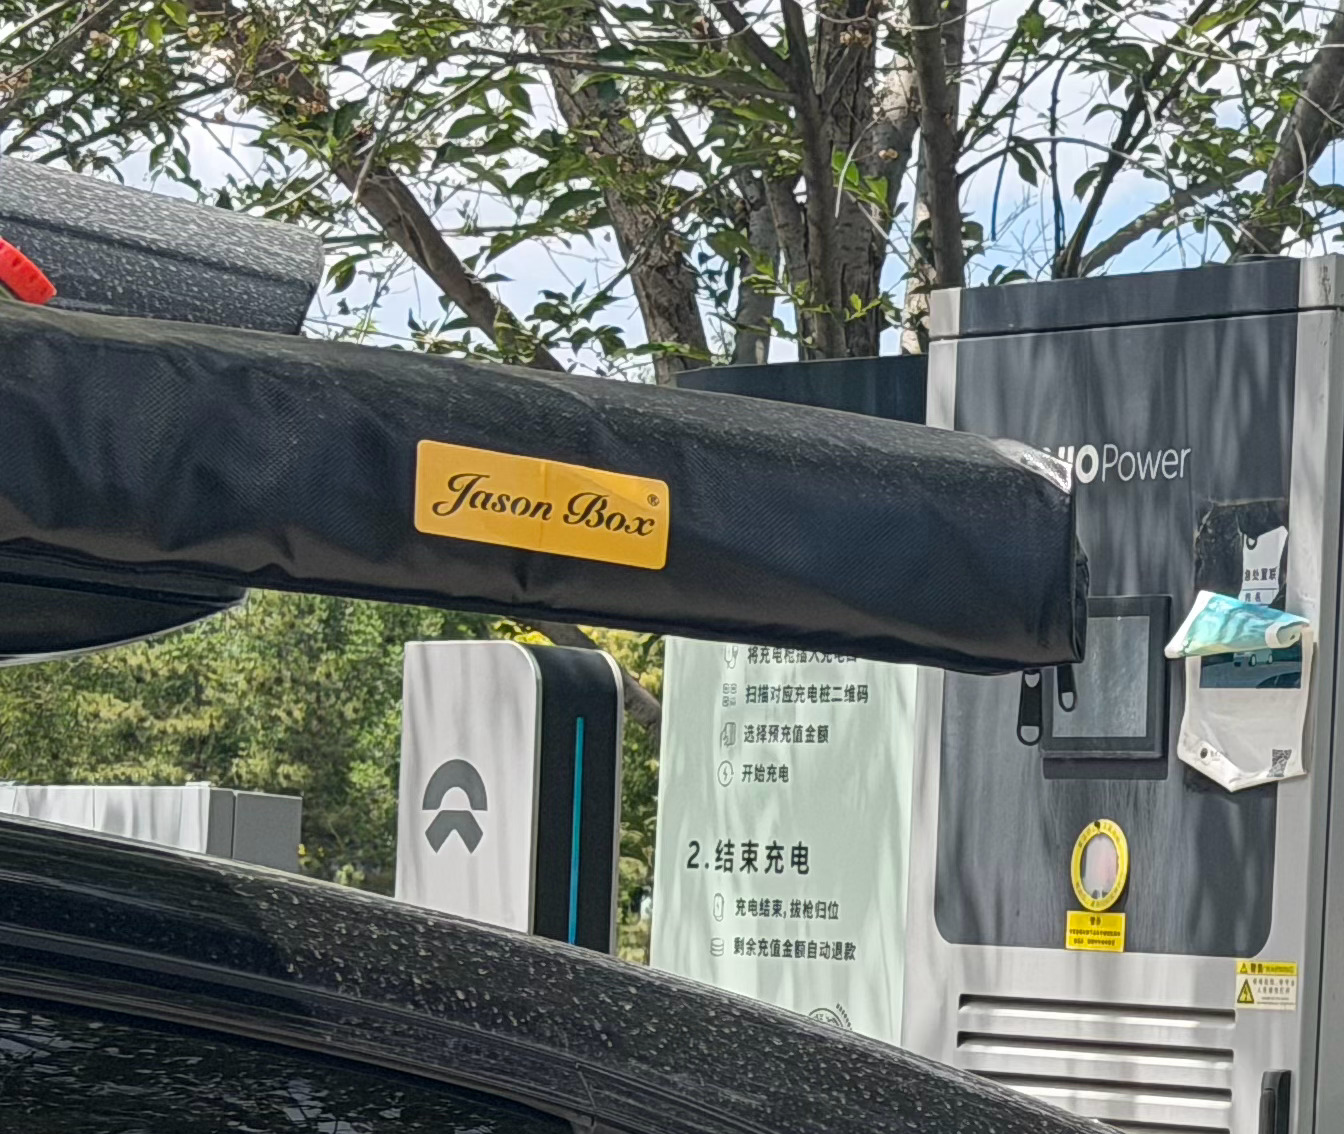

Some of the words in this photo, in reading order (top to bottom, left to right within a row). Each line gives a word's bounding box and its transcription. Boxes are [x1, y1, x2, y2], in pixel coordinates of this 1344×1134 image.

[432, 473, 553, 522] Jason
[562, 491, 656, 537] Box
[746, 684, 868, 704] 扫描对应充电桩二维码
[743, 723, 829, 745] 选择预充值金额
[741, 764, 789, 784] 开始充电
